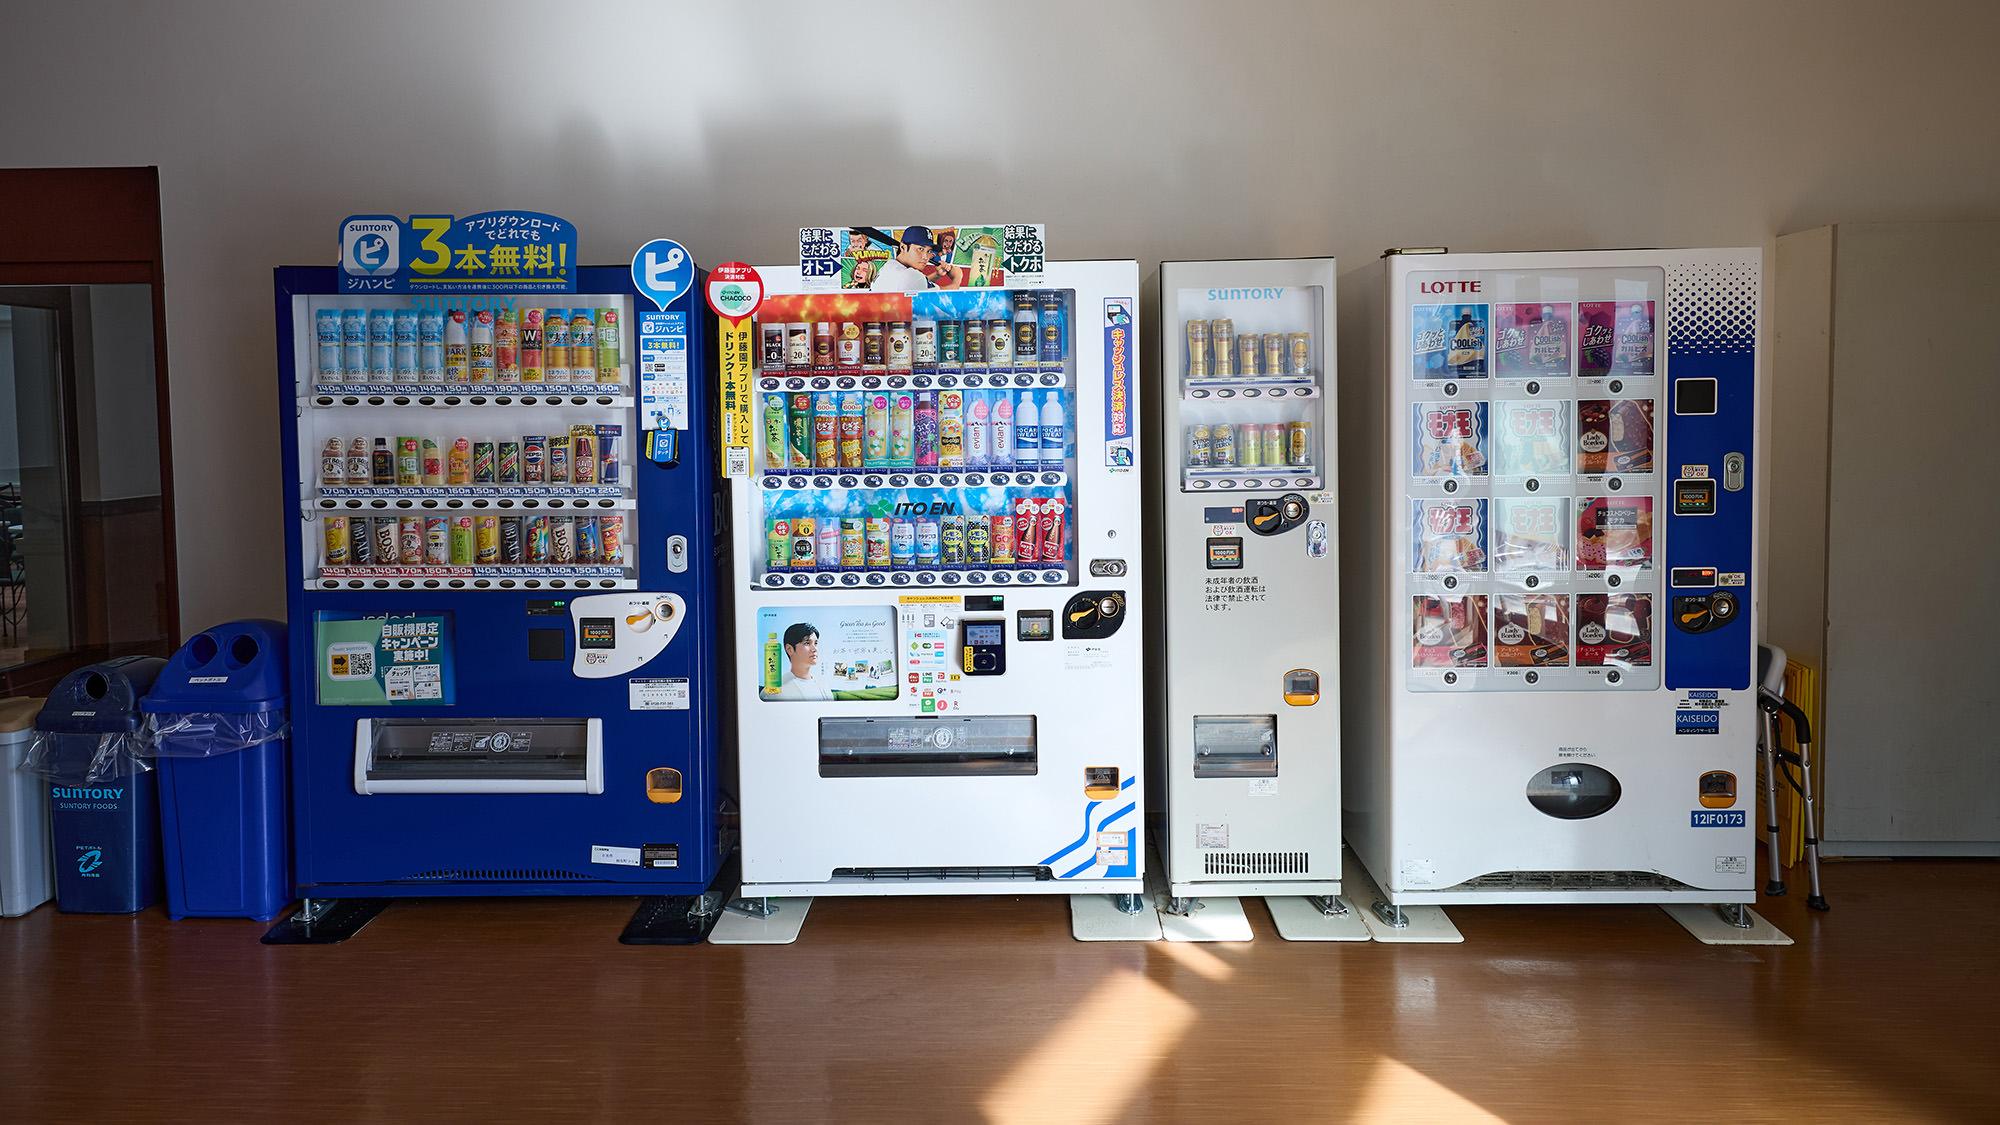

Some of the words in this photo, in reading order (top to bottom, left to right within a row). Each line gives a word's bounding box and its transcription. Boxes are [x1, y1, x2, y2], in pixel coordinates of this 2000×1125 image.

[465, 216, 561, 232] アプリダウンロード
[485, 228, 541, 241] でどれでも
[801, 230, 834, 242] 結果に
[1005, 227, 1036, 240] 結果に
[801, 243, 839, 257] こだわる
[1005, 240, 1041, 253] こだわる
[646, 248, 684, 291] ピ
[803, 260, 834, 276] オトコ
[1011, 257, 1042, 272] トクホ
[348, 278, 396, 290] ジハンピ
[1421, 281, 1481, 293] LOTTE
[1208, 288, 1284, 300] SUNTORY
[411, 296, 517, 312] SUNTORY
[524, 330, 536, 341] W
[1417, 328, 1445, 339] ゴクッと
[1498, 329, 1525, 340] ゴクッと
[1586, 326, 1613, 336] ゴクッと
[1415, 339, 1444, 350] しあわせ
[1496, 338, 1525, 349] しあわせ
[1583, 336, 1612, 346] しあわせ
[725, 332, 736, 410] ドリンク1本無料
[1112, 328, 1125, 434] キャッシュレス決済対応
[738, 332, 749, 444] 伊藤園アプリで購入して
[816, 422, 834, 430] むぎ茶
[842, 422, 860, 430] むぎ茶
[1429, 412, 1471, 437] モナ王
[1512, 411, 1554, 436] モナ王
[894, 502, 927, 516] ITO
[930, 502, 955, 515] EN
[1430, 509, 1471, 532] モナ王
[1512, 508, 1554, 532] モナ王
[353, 524, 371, 562] BLACK
[380, 529, 396, 560] BOSS
[504, 526, 521, 561] BLACK
[555, 528, 571, 560] BOSS
[1205, 576, 1259, 585] 未成年者の飲酒
[1205, 586, 1266, 594] および飲酒運転は
[1205, 594, 1266, 602] 法律で禁止されて
[1205, 603, 1232, 611] います。
[382, 622, 439, 636] 自販機限定
[382, 637, 439, 649] キャンペーン
[394, 650, 429, 661] 実施中!
[52, 787, 124, 799] SUNTORY
[1694, 814, 1743, 825] 12IF0173
